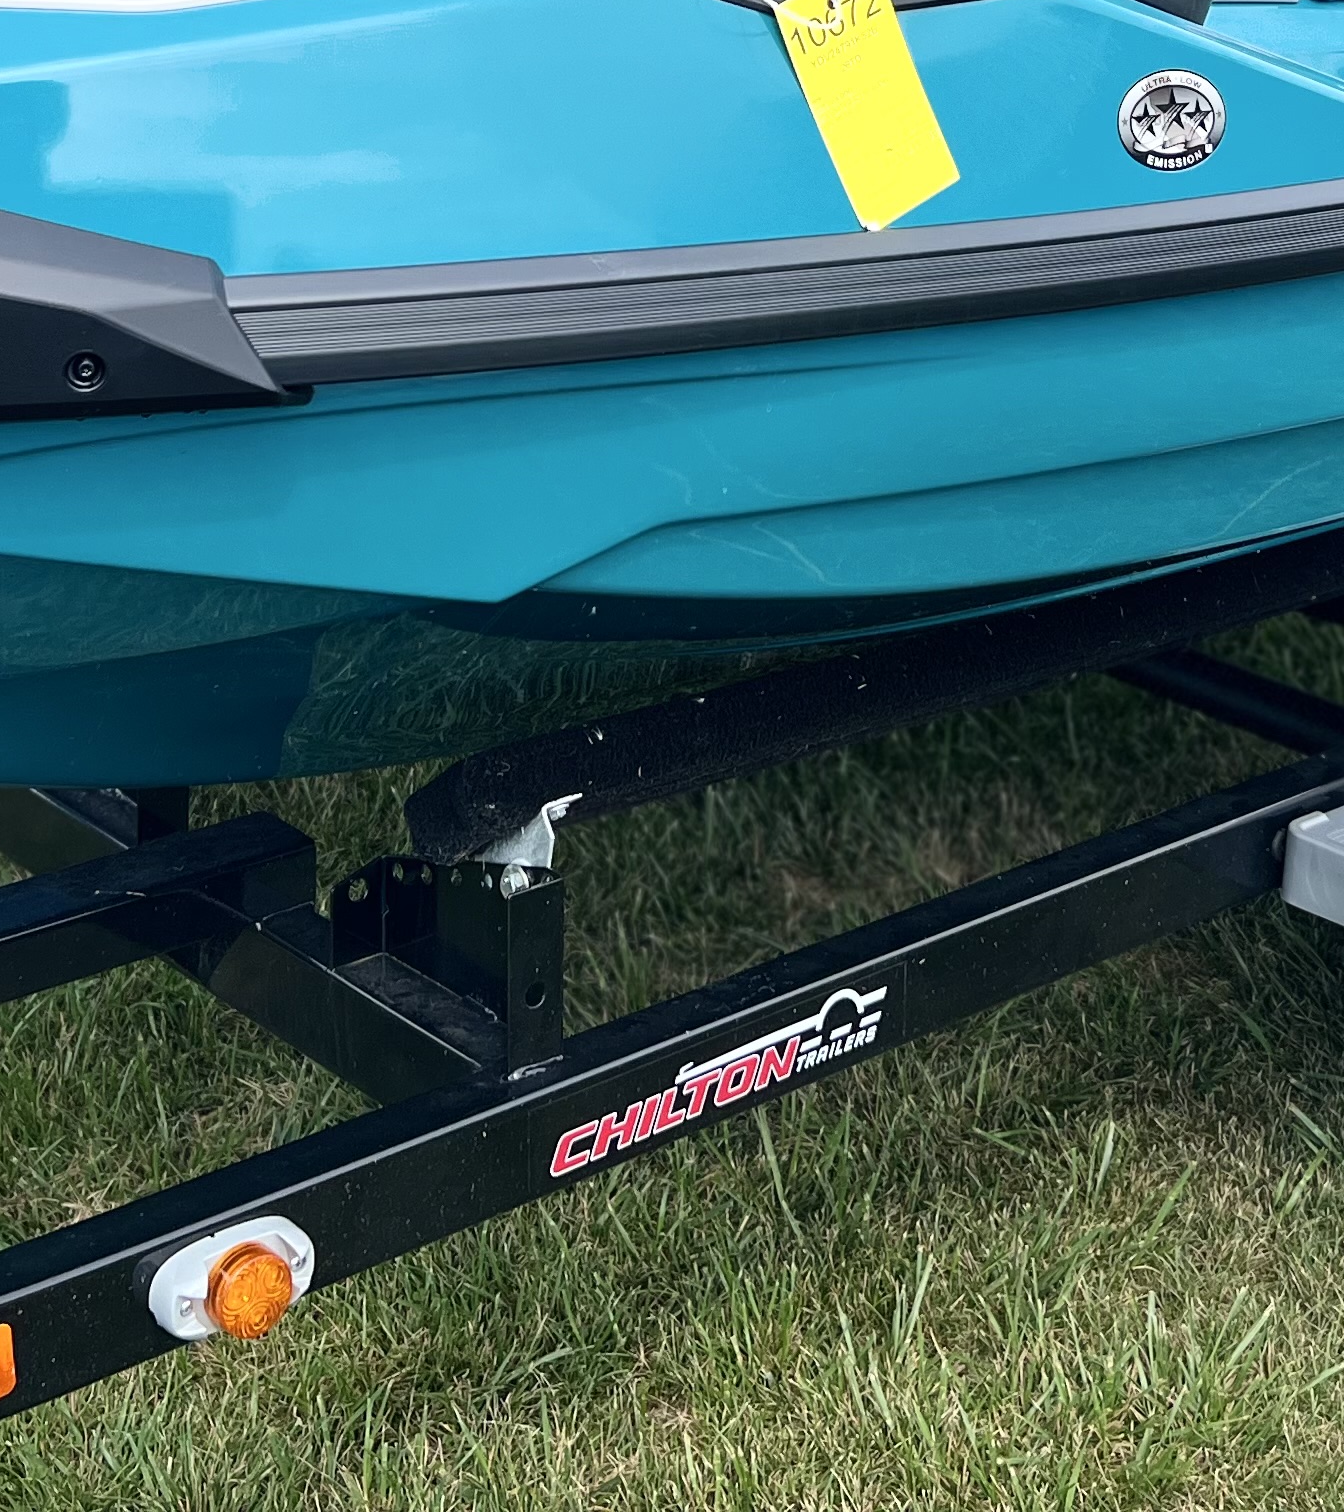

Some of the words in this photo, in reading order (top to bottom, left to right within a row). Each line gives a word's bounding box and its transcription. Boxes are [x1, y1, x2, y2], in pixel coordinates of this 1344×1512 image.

[1140, 75, 1171, 93] ULTRA
[1180, 77, 1202, 89] LOW
[1147, 149, 1203, 169] EMISSION
[795, 1024, 878, 1073] TRAILERS
[550, 1036, 801, 1177] CHILTON
